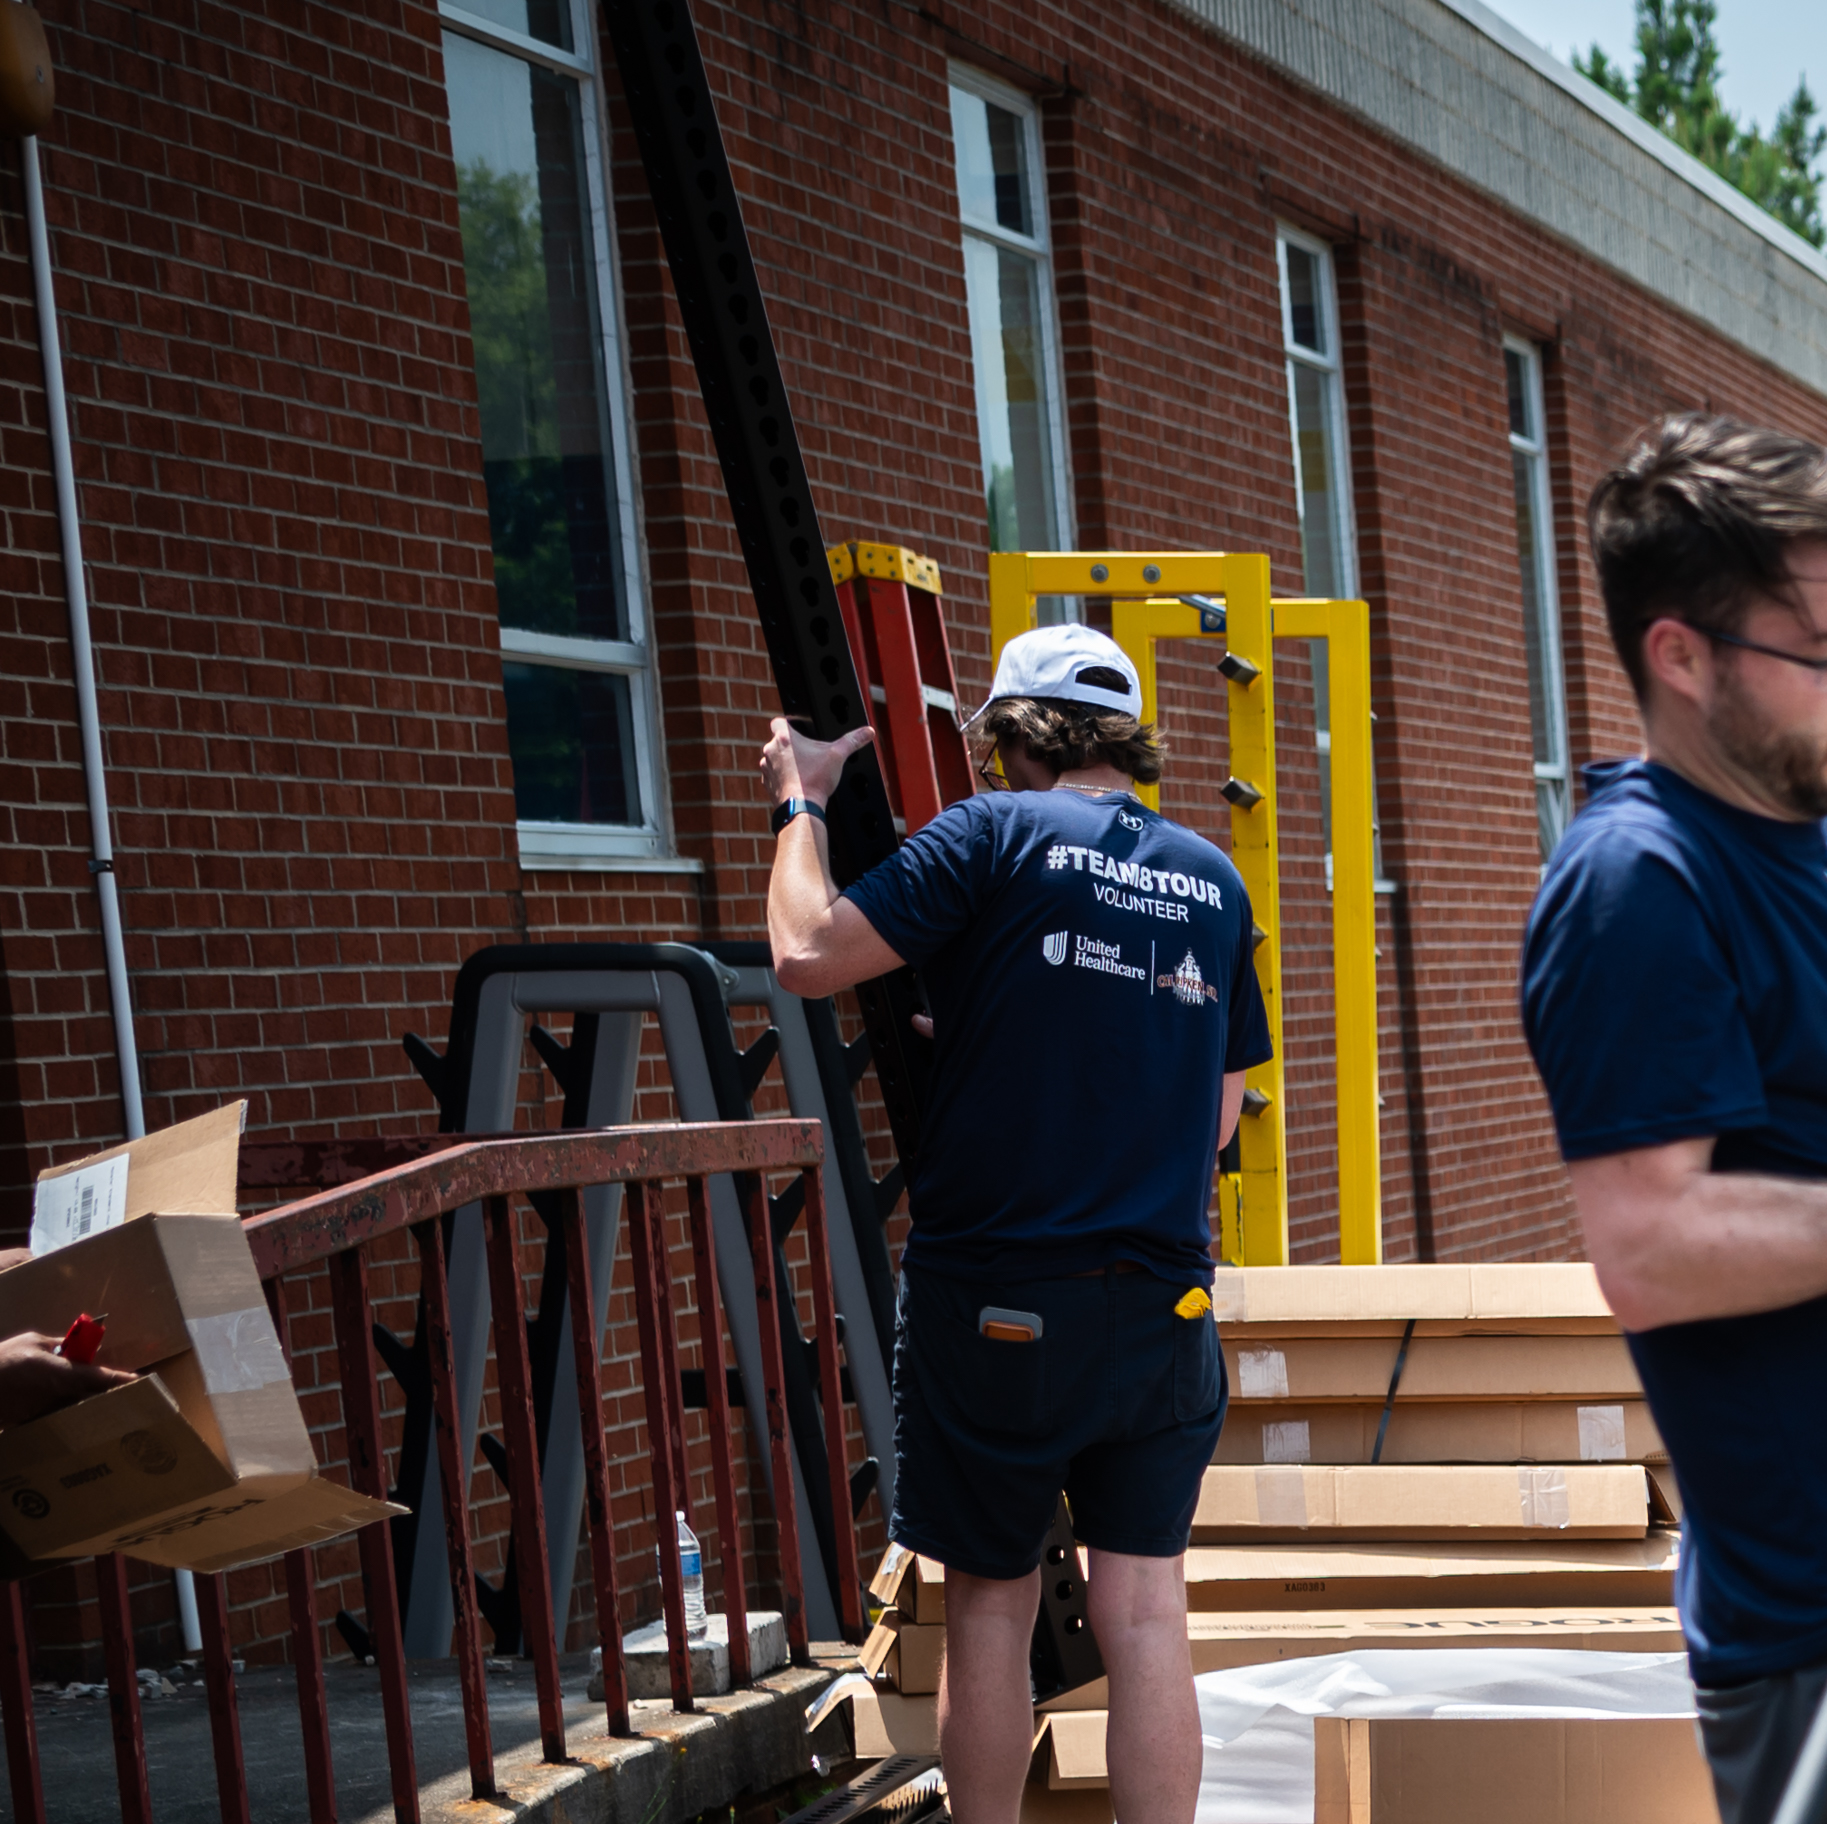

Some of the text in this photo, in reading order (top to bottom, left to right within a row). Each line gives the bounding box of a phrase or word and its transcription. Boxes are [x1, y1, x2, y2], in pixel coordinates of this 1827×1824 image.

[1048, 845, 1222, 911] #TEAM8TOUR
[1094, 882, 1189, 923] VOLUNTEER
[1076, 934, 1120, 959] United
[1074, 951, 1146, 981] Healthcare
[1363, 1617, 1676, 1630] ROGUE
